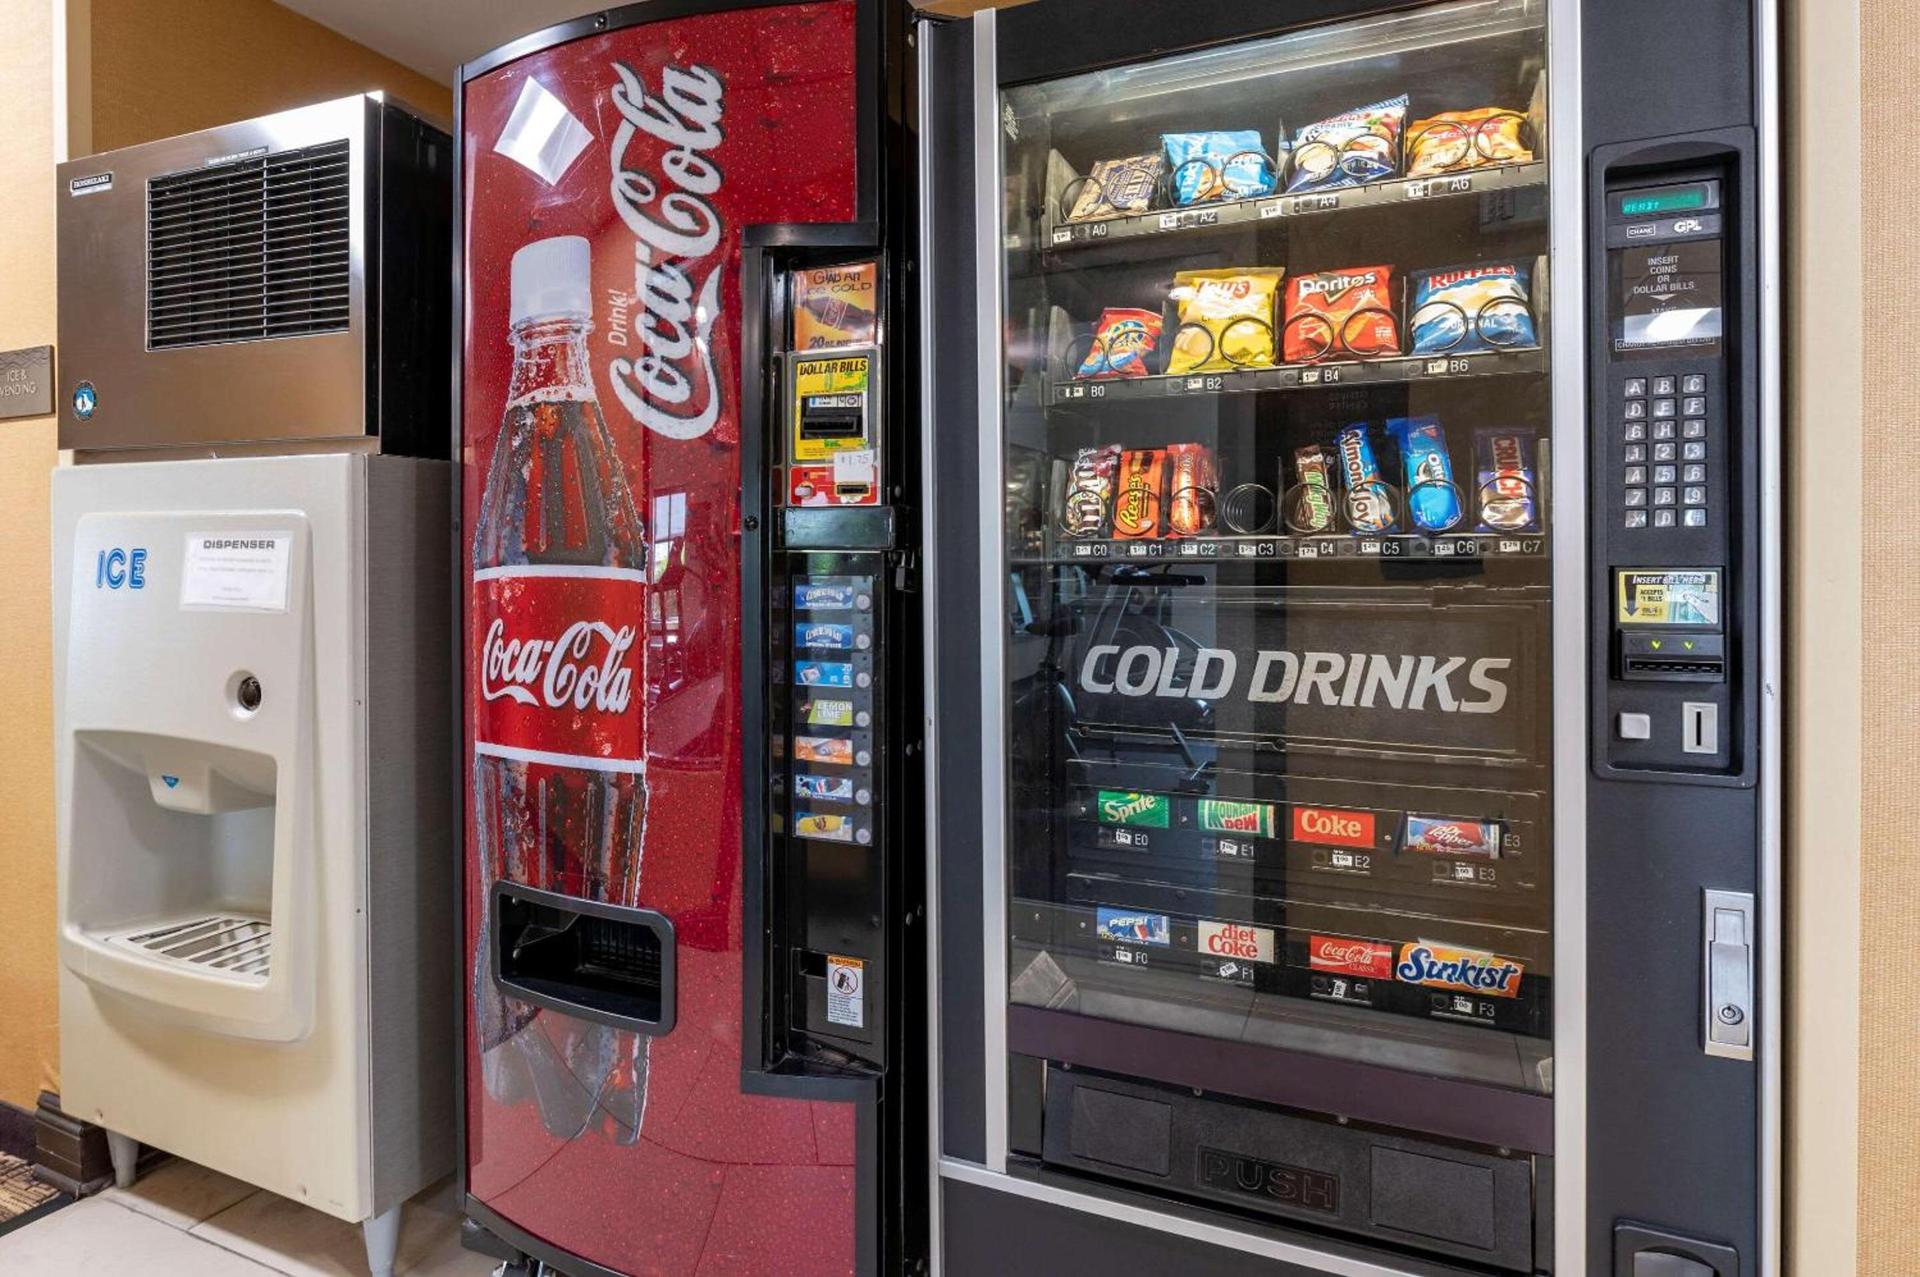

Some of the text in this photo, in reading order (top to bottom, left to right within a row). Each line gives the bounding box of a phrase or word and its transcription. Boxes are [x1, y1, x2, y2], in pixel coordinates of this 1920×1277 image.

[1451, 179, 1469, 191] A6
[1320, 197, 1336, 208] A4
[1200, 211, 1215, 223] A2
[1674, 219, 1702, 233] GPL
[610, 62, 725, 440] Coca-Cola
[1647, 255, 1679, 265] INSERT
[1649, 265, 1677, 274] COINS
[1299, 272, 1377, 296] Doritos
[1657, 274, 1670, 283] OR
[1633, 281, 1695, 294] DOLLAR BILLS
[608, 289, 628, 346] Drink!
[809, 336, 825, 348] 20
[800, 360, 867, 375] DOLLAR BILLS
[1451, 360, 1469, 372] B6
[7, 369, 20, 382] ICE
[1324, 370, 1339, 382] B4
[1206, 378, 1222, 389] B2
[1340, 429, 1366, 496] Almond
[1492, 437, 1527, 498] CRUNCH
[1119, 472, 1143, 528] Reese's
[1349, 492, 1373, 525] Joy
[203, 539, 276, 550] DISPENSER
[1150, 544, 1163, 556] C1
[1200, 544, 1215, 556] C2
[1258, 543, 1274, 555] C3
[1321, 542, 1333, 554] C4
[1382, 542, 1399, 555] C5
[1457, 540, 1475, 553] C6
[1522, 540, 1541, 553] C7
[96, 548, 148, 589] ICE
[1632, 575, 1661, 585] INSERT
[1663, 575, 1682, 585] BILL
[482, 618, 635, 713] Coca-Cola
[1080, 645, 1511, 713] COLD DRINKS
[1104, 794, 1157, 823] Sprite
[1301, 810, 1361, 838] Coke
[1428, 826, 1474, 845] Pepper
[1504, 834, 1520, 847] E3
[1241, 844, 1254, 857] E1
[1355, 855, 1370, 868] E2
[1479, 868, 1496, 880] E3
[1109, 915, 1149, 927] PEPSI
[1222, 924, 1256, 941] diet
[1208, 934, 1258, 959] Coke
[1320, 942, 1373, 964] Coca-Cola
[1242, 968, 1255, 981] F1
[1398, 947, 1517, 991] Sunkist
[1479, 1003, 1495, 1017] F3
[1204, 1152, 1337, 1210] PUSH
